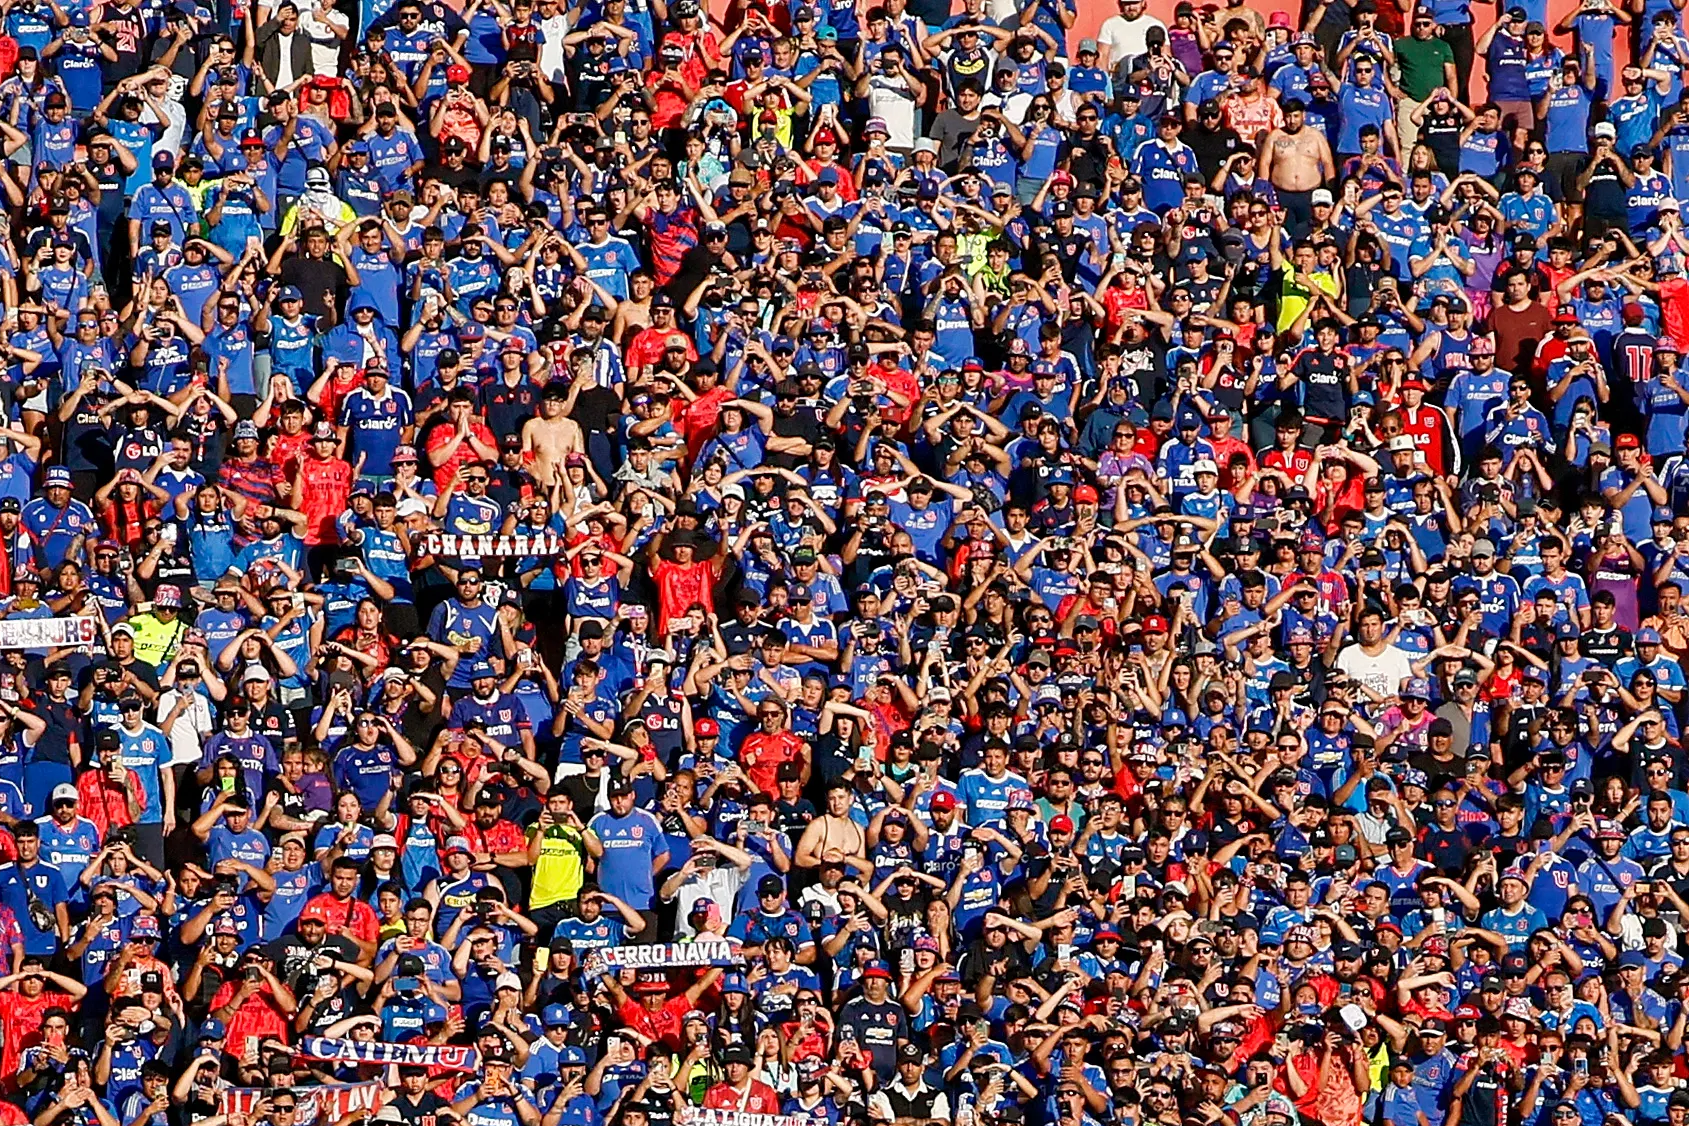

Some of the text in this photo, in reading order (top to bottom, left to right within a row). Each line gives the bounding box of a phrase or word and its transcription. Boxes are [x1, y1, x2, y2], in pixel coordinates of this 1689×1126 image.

[1628, 195, 1660, 208] Claro
[1625, 345, 1653, 382] 11
[1309, 372, 1340, 385] Claro
[1414, 433, 1431, 445] LG
[142, 446, 159, 457] LG
[663, 717, 678, 730] LG
[600, 943, 666, 966] CERRO
[671, 941, 732, 962] NAVIA
[312, 1037, 469, 1068] CATEMU
[693, 1107, 718, 1126] LA
